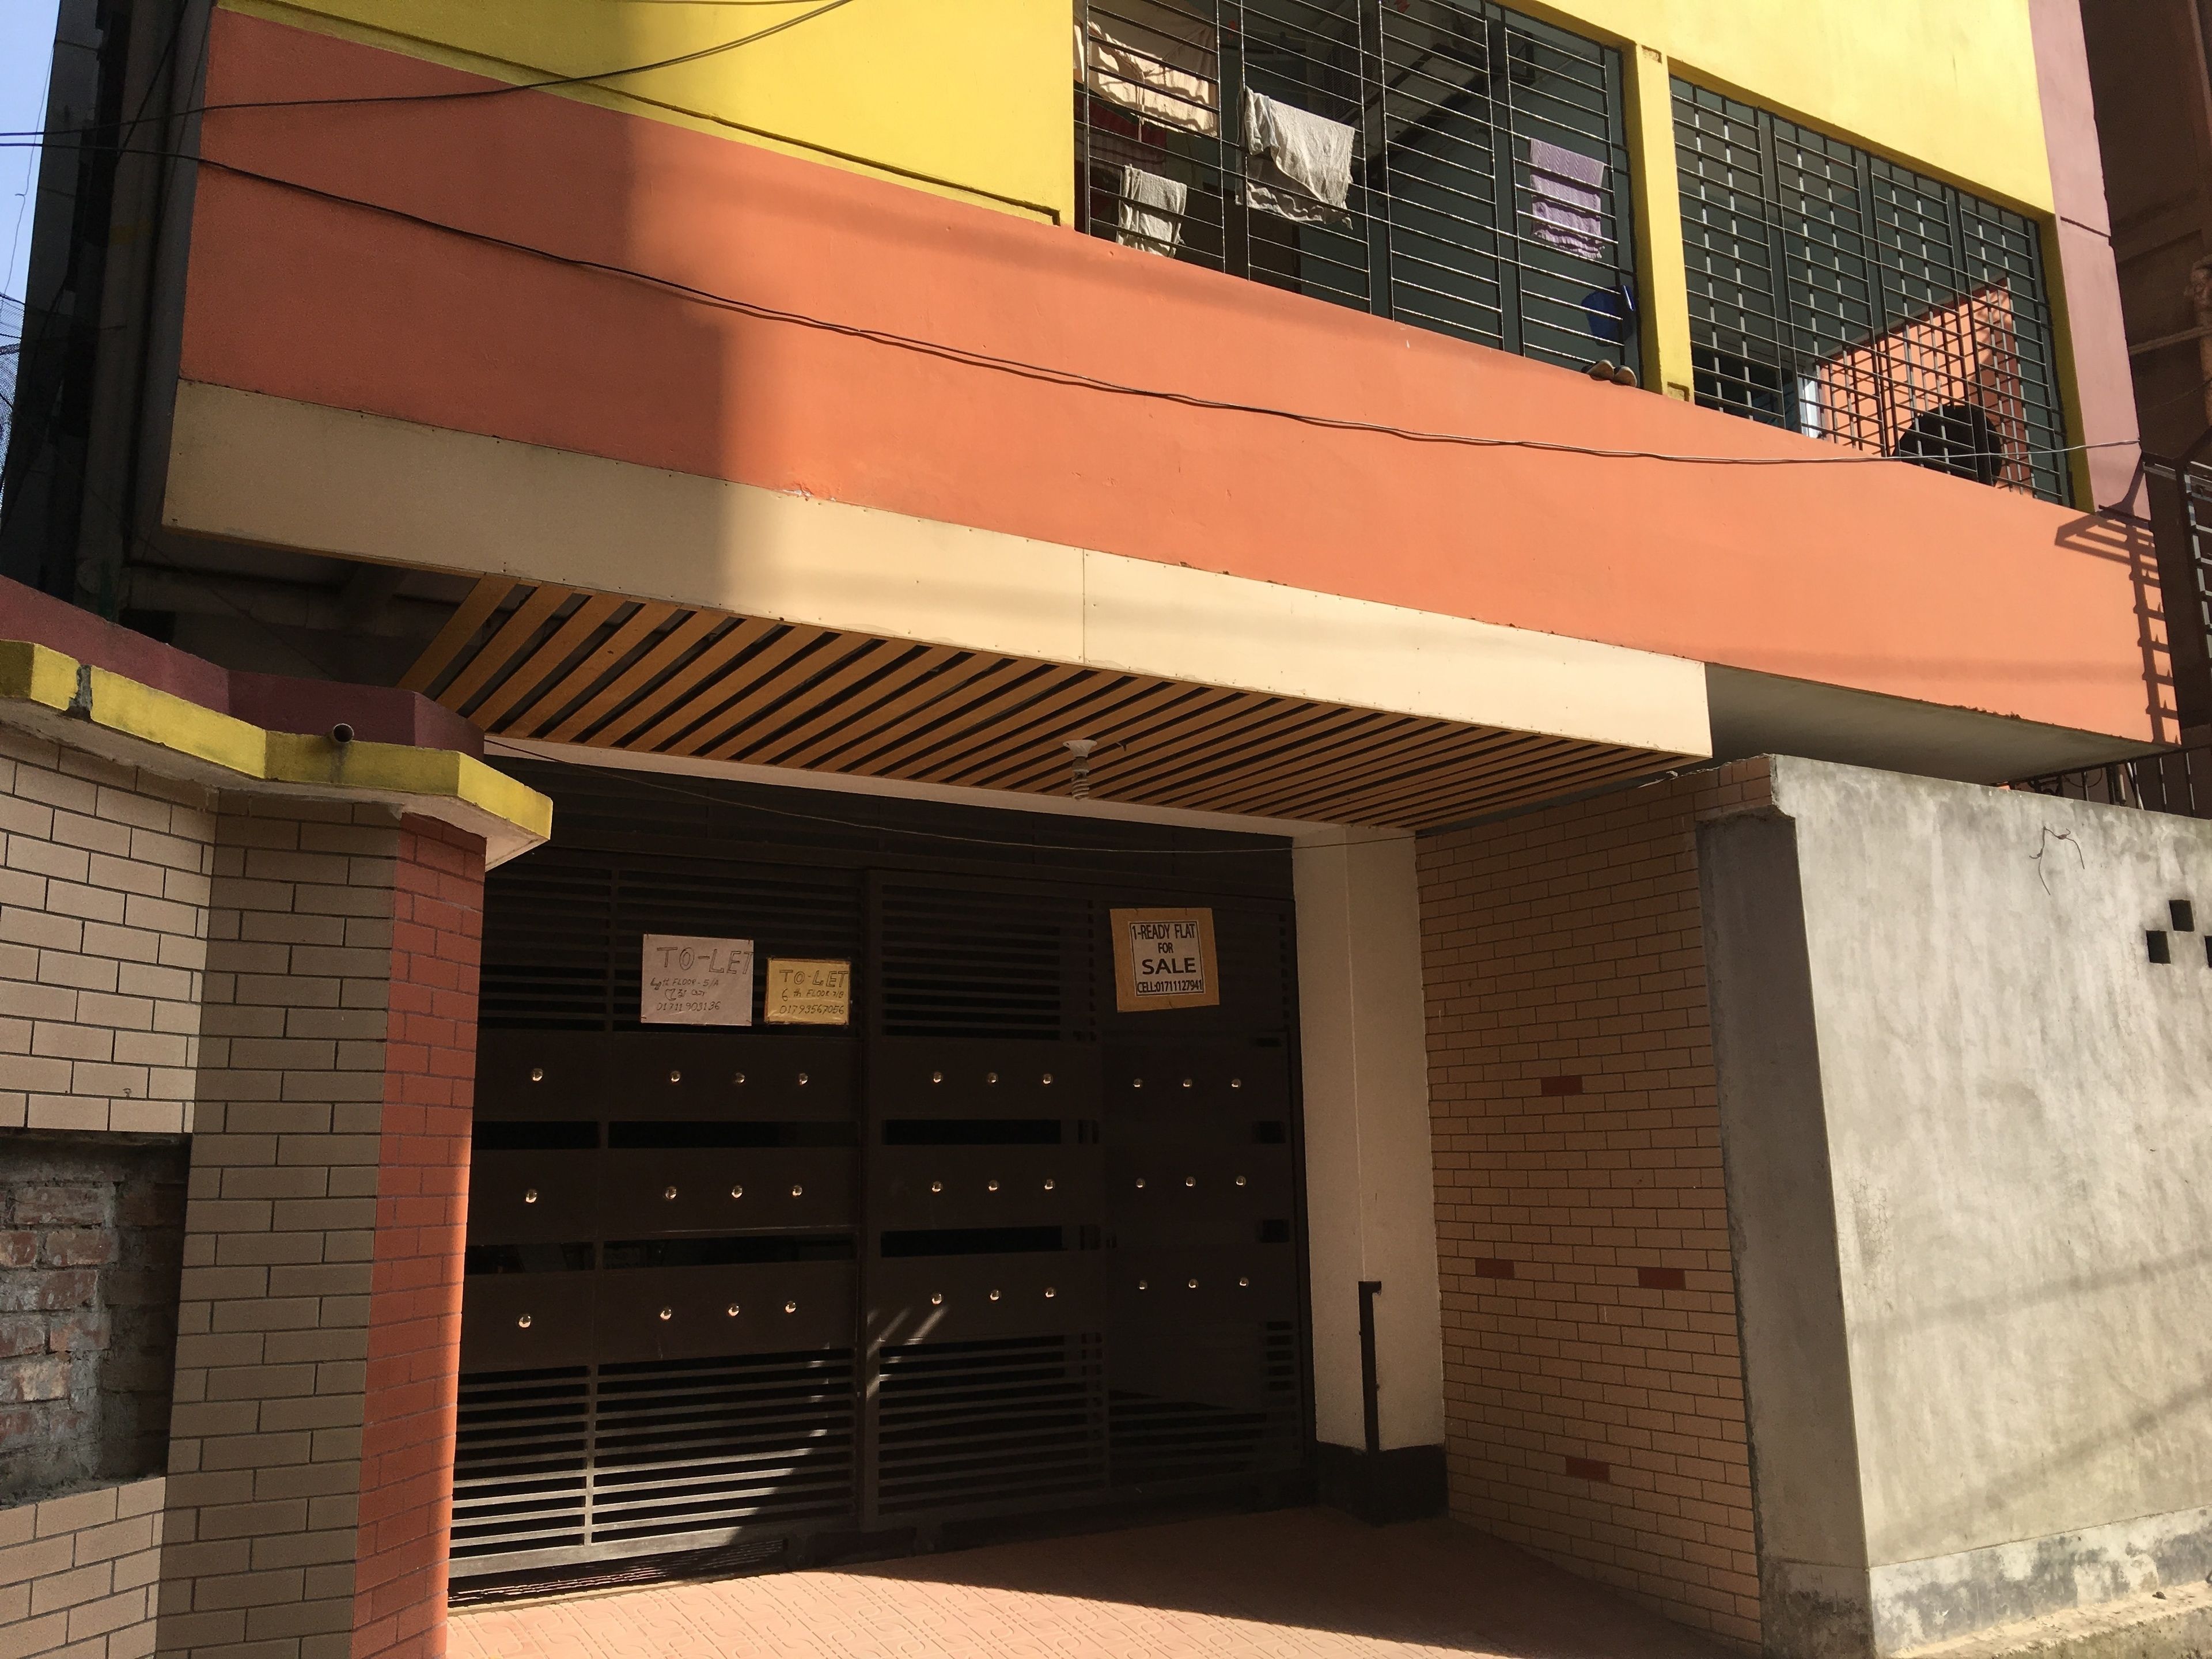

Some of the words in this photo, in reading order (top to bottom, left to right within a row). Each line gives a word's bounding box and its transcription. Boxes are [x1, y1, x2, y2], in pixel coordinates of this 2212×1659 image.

[1132, 924, 1171, 940] 1-READY
[1175, 923, 1195, 938] FLAT
[1158, 942, 1173, 953] FOR
[657, 947, 753, 975] TO-LET
[1142, 957, 1196, 975] SALE
[779, 969, 849, 987] TO-LET
